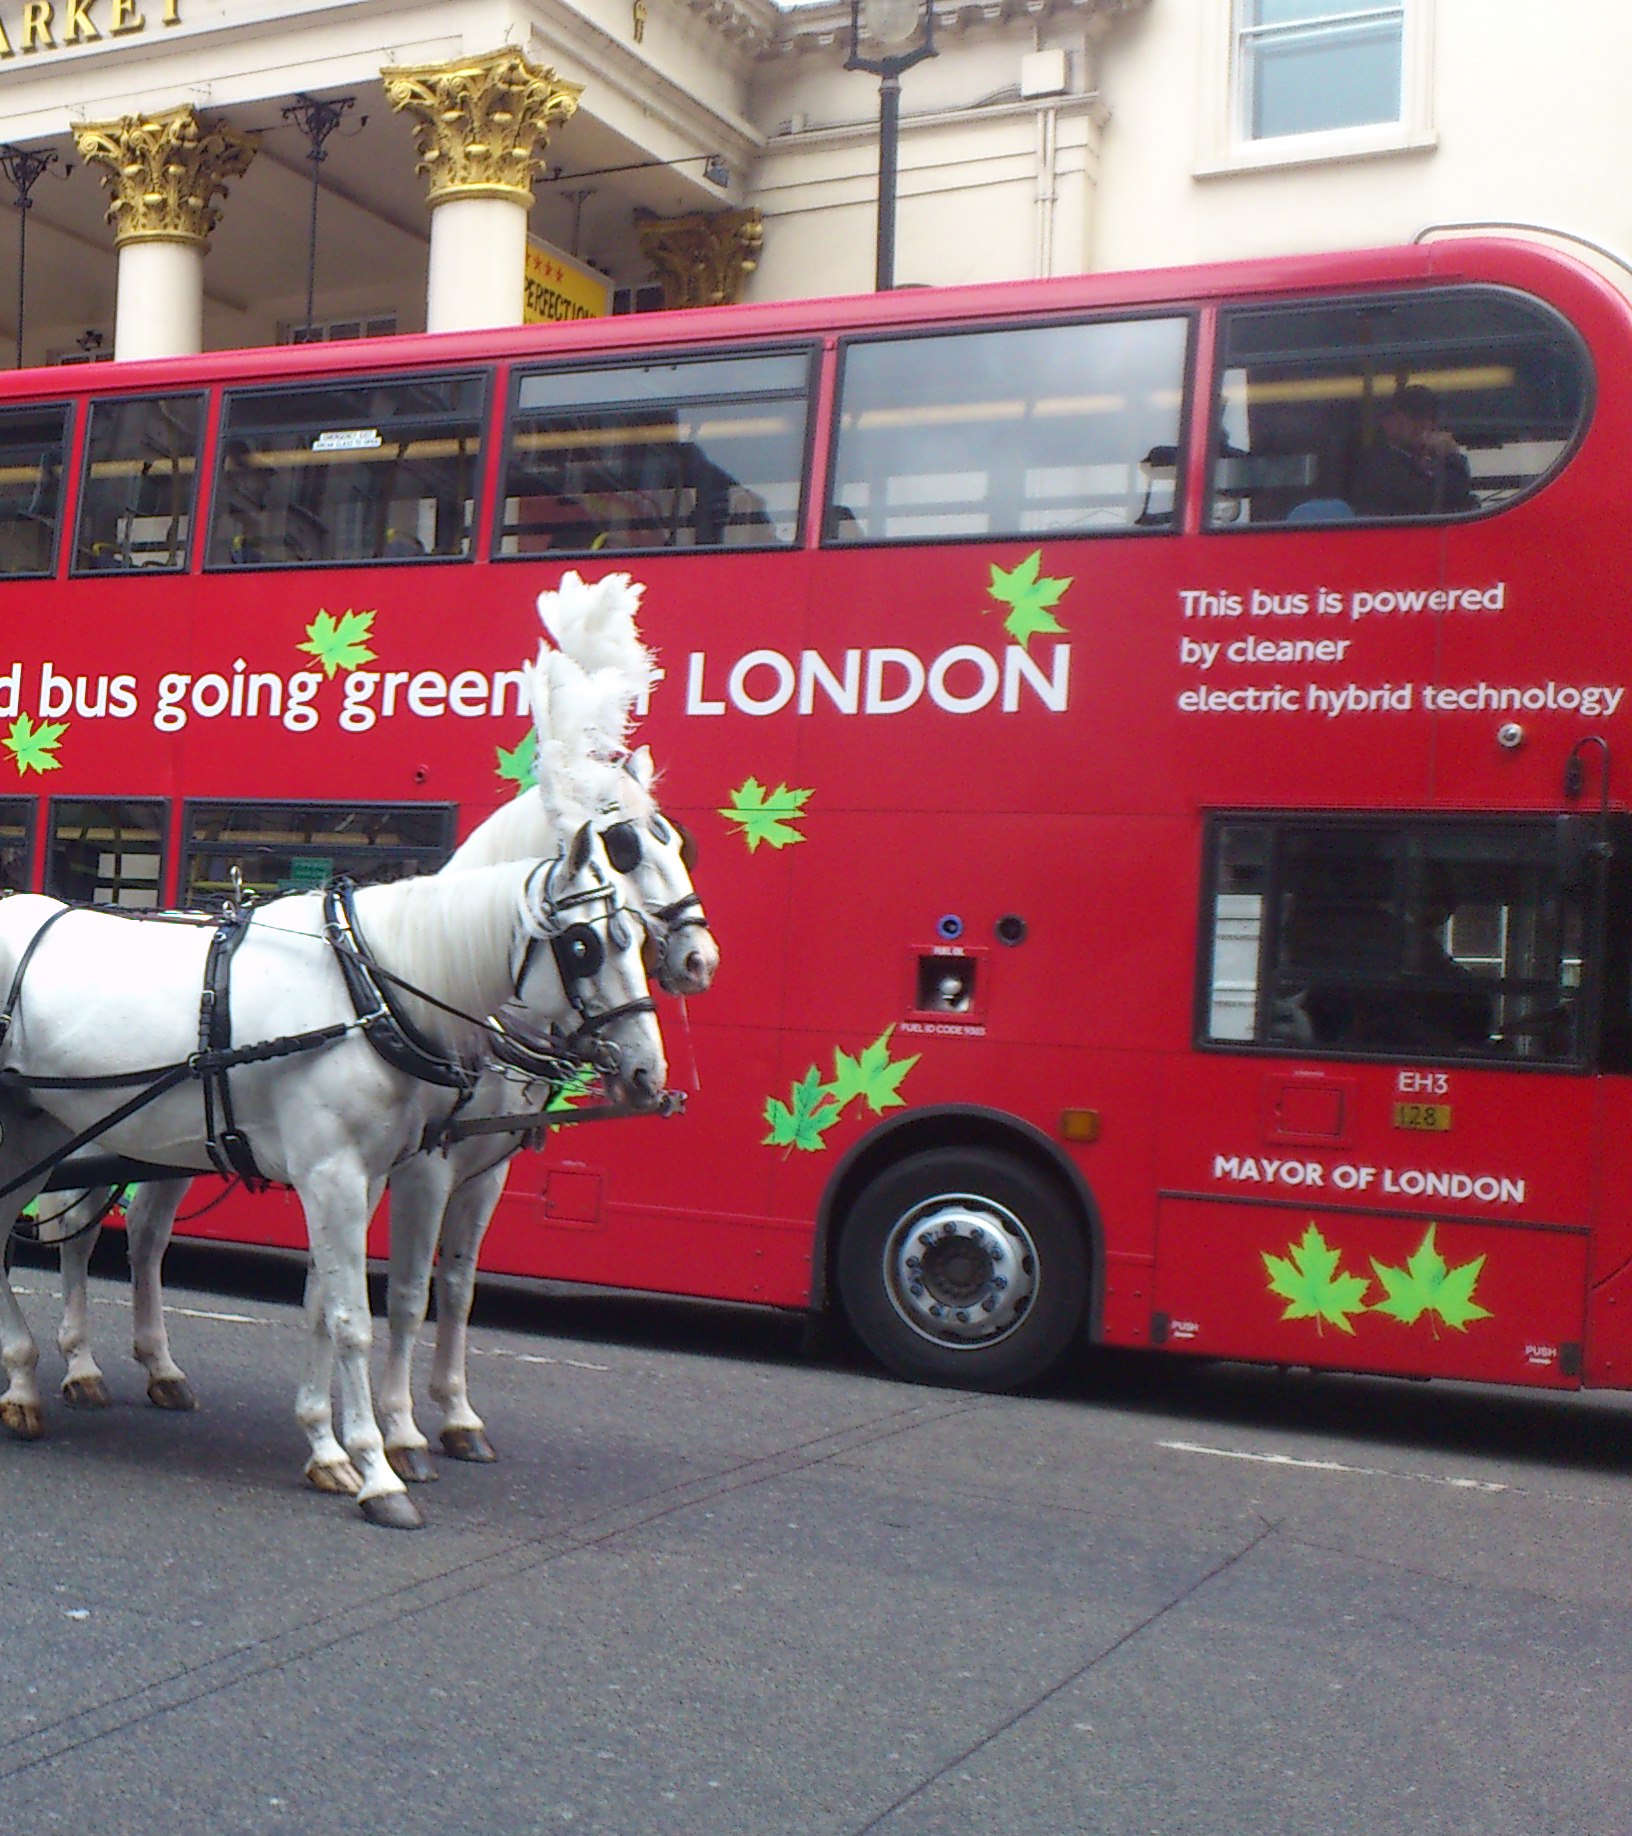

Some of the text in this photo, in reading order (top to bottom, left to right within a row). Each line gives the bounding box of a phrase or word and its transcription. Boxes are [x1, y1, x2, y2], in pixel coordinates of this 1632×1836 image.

[524, 276, 597, 321] ERFECTIO
[1180, 582, 1505, 622] This bus is powered
[1179, 635, 1352, 670] by cleaner
[38, 662, 138, 719] bus
[154, 658, 323, 732] going
[338, 670, 531, 731] green
[685, 643, 1070, 717] LONDON
[1177, 679, 1625, 718] electric hybrid technology
[900, 1023, 923, 1033] FUEL
[936, 1025, 963, 1034] CODE
[1398, 1071, 1449, 1094] EH3
[1401, 1106, 1436, 1127] 128
[1214, 1155, 1526, 1204] MAYOR OF LONDON
[1171, 1320, 1199, 1332] PUSH
[1525, 1345, 1557, 1358] PUSH
